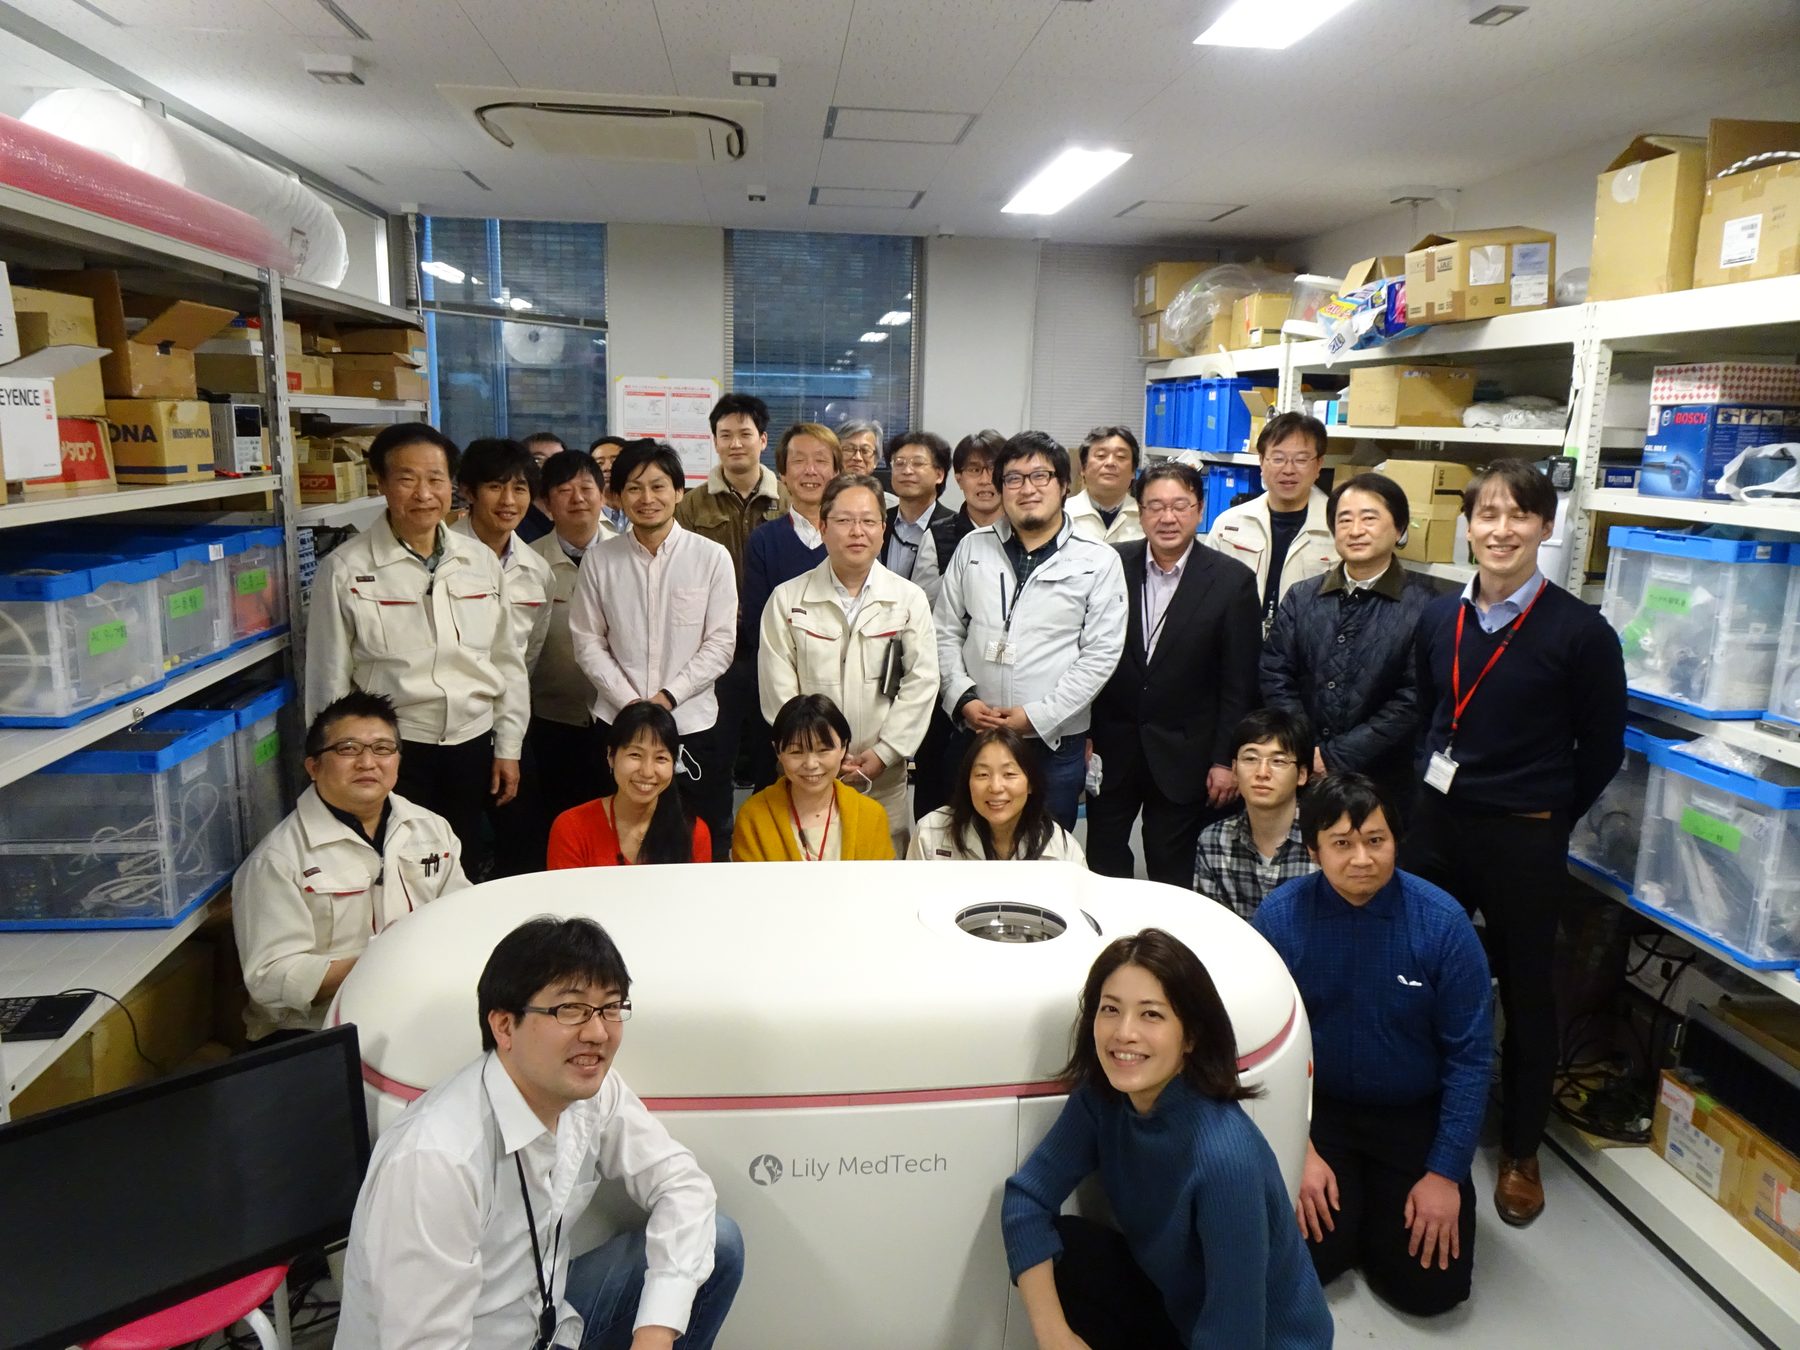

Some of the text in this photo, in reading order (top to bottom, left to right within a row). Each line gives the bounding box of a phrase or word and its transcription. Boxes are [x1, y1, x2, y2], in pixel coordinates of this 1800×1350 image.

[0, 388, 40, 406] EYENCE
[1674, 411, 1708, 425] BOSCH
[792, 1153, 947, 1182] Lily MedTech
